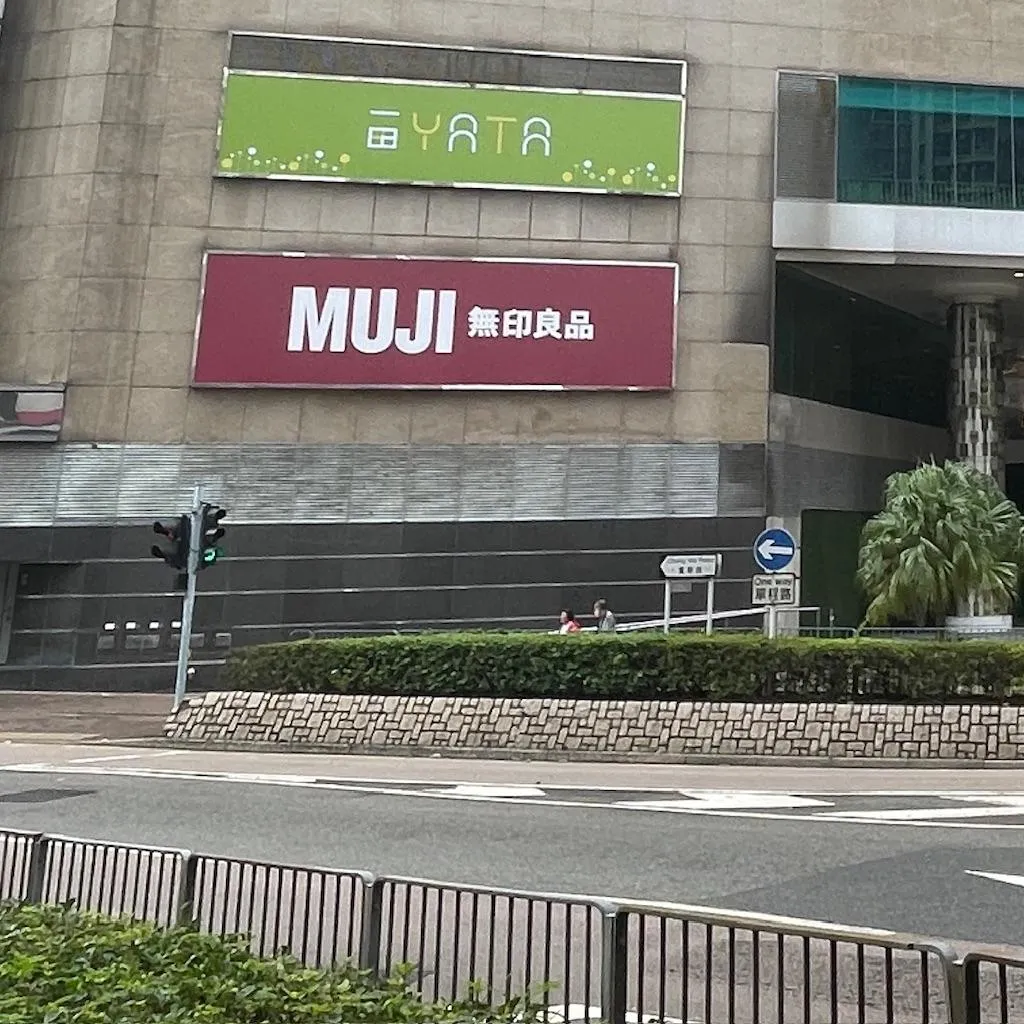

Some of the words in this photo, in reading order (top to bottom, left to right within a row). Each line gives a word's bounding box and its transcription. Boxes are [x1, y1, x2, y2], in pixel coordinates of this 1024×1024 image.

[366, 108, 401, 150] 一田
[411, 112, 552, 157] YATA
[287, 286, 457, 355] MUJI
[467, 305, 595, 341] 無印良品
